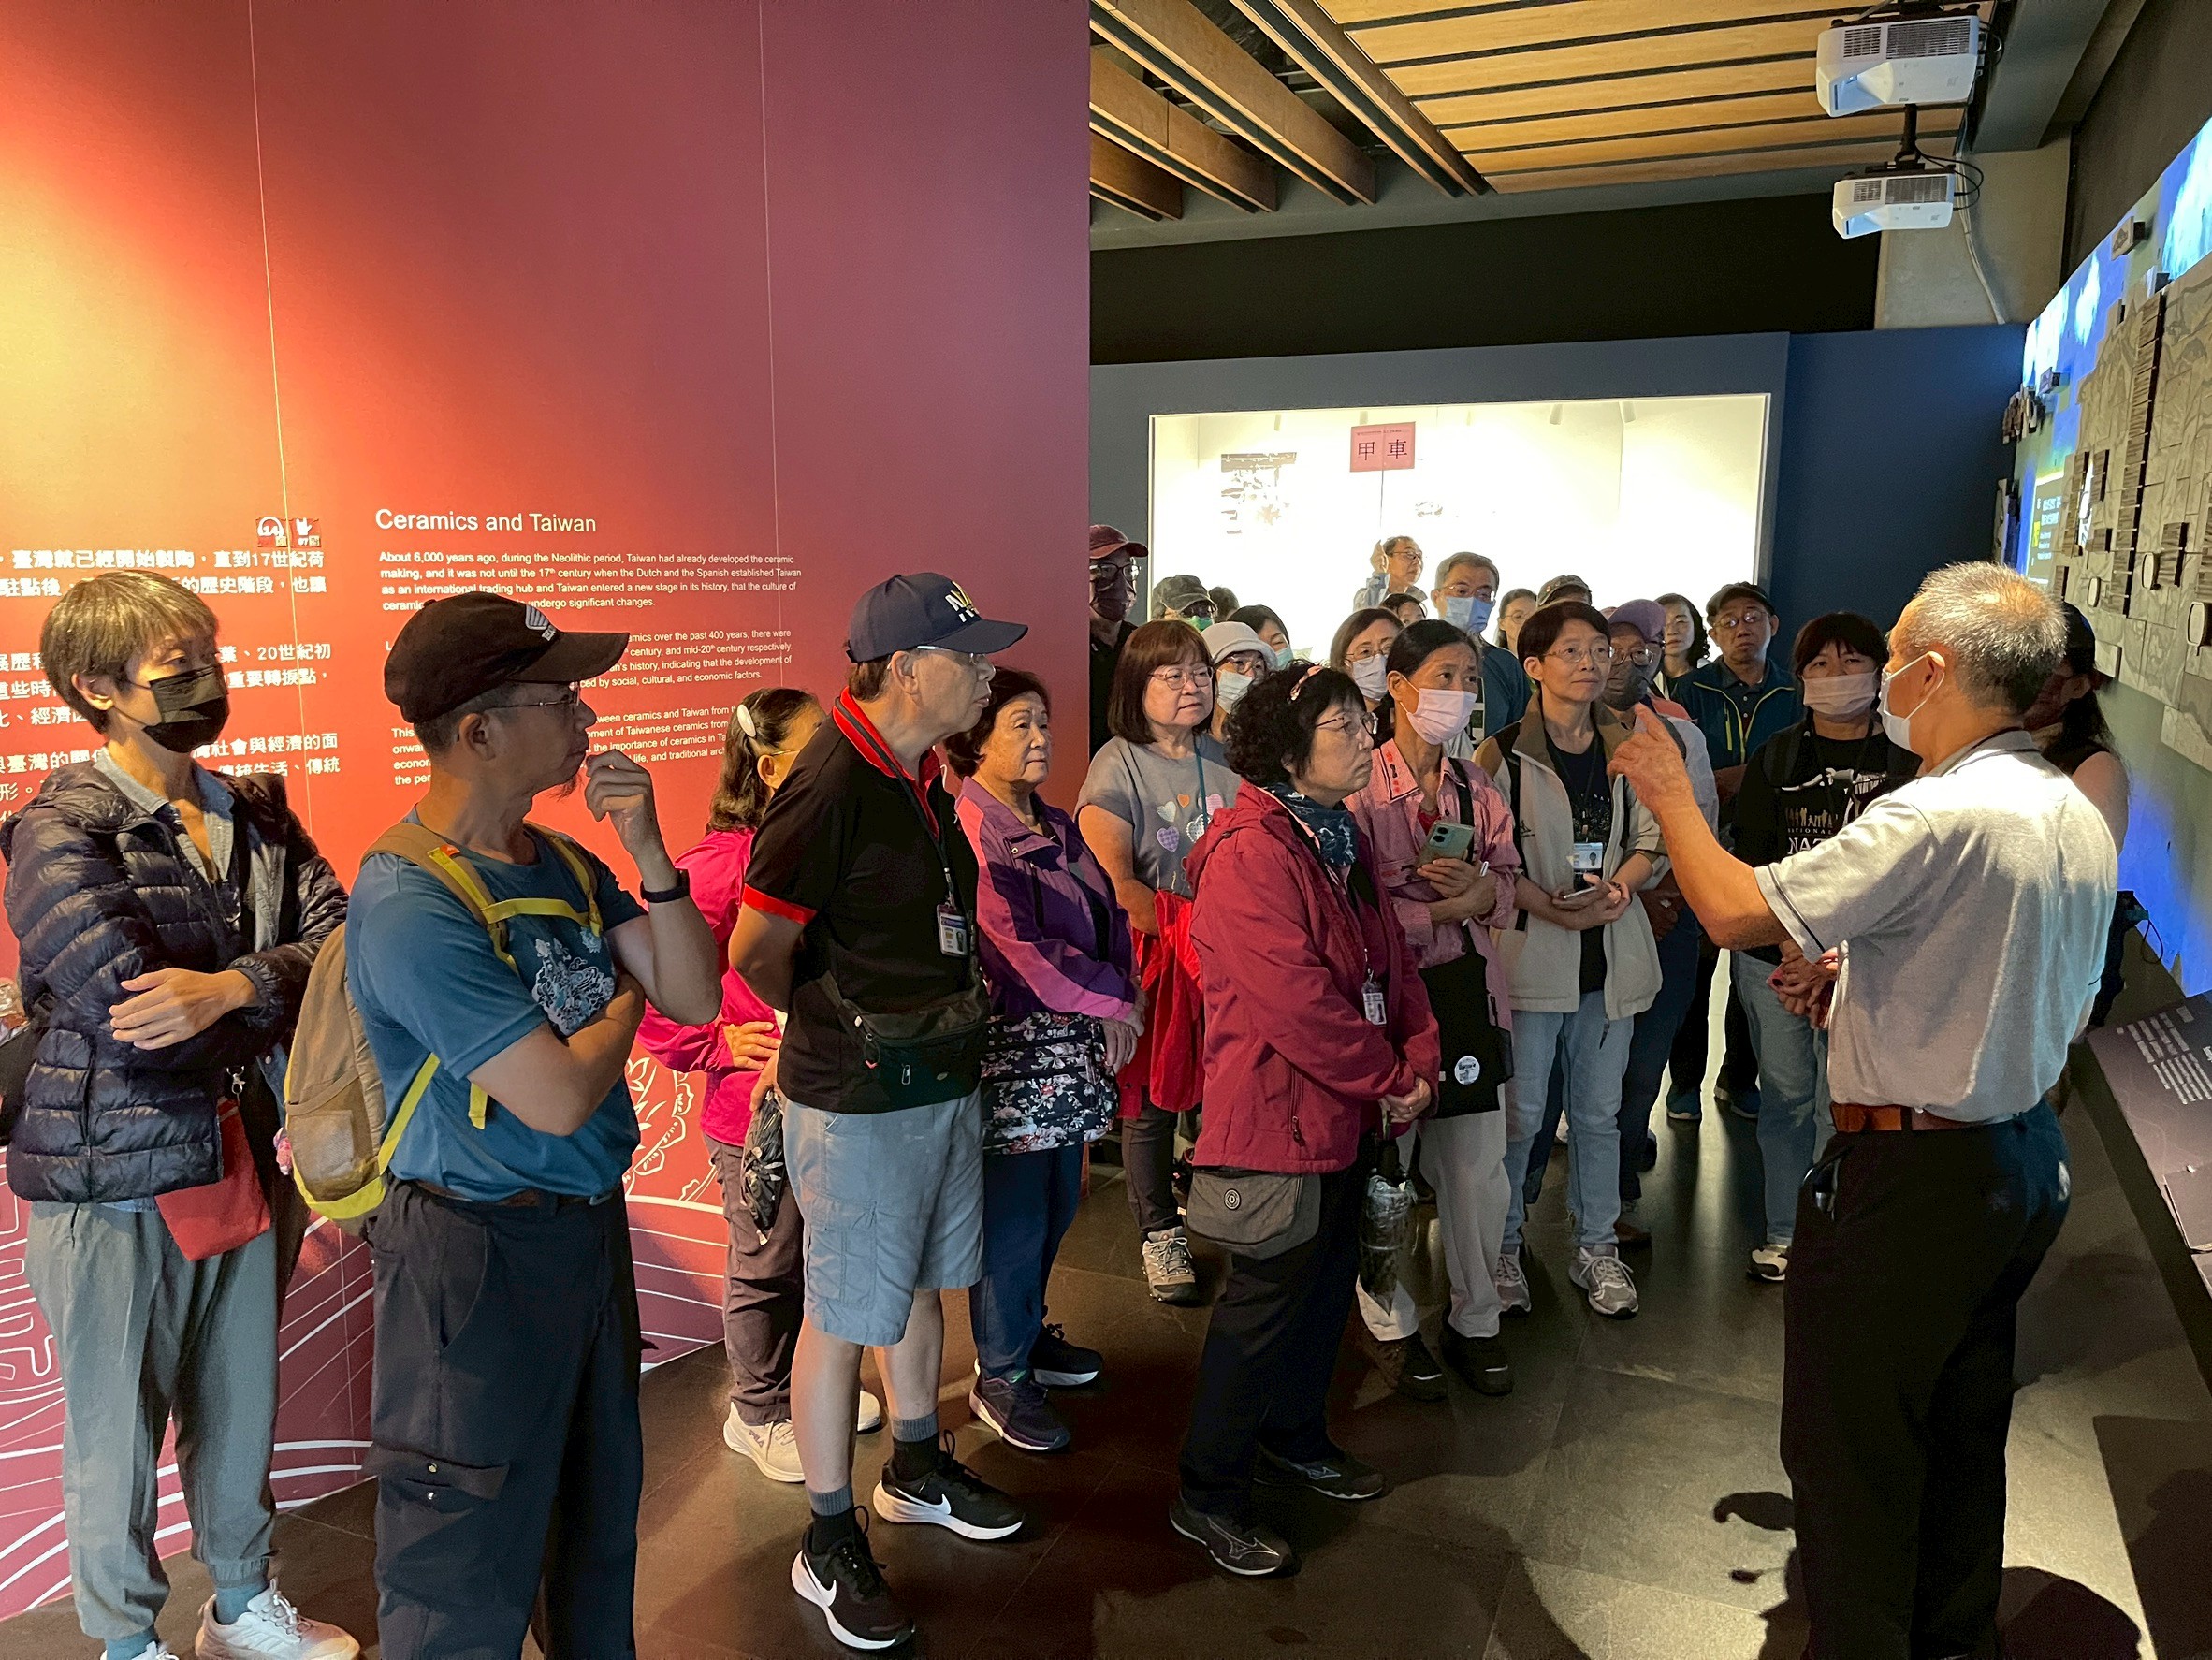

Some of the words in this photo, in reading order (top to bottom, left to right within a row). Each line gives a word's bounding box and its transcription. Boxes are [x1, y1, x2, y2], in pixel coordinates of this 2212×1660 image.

[375, 508, 478, 531] Ceramics
[486, 513, 522, 531] and
[529, 513, 596, 532] Taiwan
[379, 552, 411, 563] About
[414, 552, 444, 564] 6,000
[446, 554, 474, 564] years
[476, 554, 499, 564] ago,
[501, 553, 531, 564] during
[533, 553, 548, 562] the
[551, 553, 591, 563] Neolithic
[593, 554, 624, 564] period,
[626, 554, 656, 563] Taiwan
[659, 554, 675, 563] had
[677, 554, 706, 565] already
[708, 555, 749, 565] developed
[750, 555, 763, 563] the
[764, 555, 794, 563] ceramic
[380, 568, 423, 580] making,
[425, 568, 444, 578] and
[447, 568, 455, 578] it
[457, 570, 477, 578] was
[479, 569, 496, 578] not
[498, 568, 517, 578] until
[520, 568, 536, 577] the
[558, 569, 591, 580] century
[594, 569, 618, 578] when
[620, 568, 634, 577] the
[636, 568, 662, 577] Dutch
[663, 568, 679, 577] and
[681, 568, 694, 577] the
[696, 568, 729, 579] Spanish
[731, 568, 774, 577] established
[776, 568, 802, 577] Taiwan
[382, 586, 395, 594] as
[398, 586, 411, 594] an
[414, 584, 476, 594] international
[479, 583, 513, 595] trading
[516, 584, 533, 593] hub
[536, 584, 554, 593] and
[556, 583, 589, 593] Taiwan
[590, 583, 624, 592] entered
[635, 584, 653, 592] new
[655, 583, 678, 593] stage
[680, 583, 688, 591] in
[690, 582, 699, 591] its
[701, 582, 730, 592] history,
[731, 582, 747, 591] that
[748, 582, 760, 591] the
[762, 582, 787, 591] culture
[788, 581, 797, 590] of
[569, 598, 615, 609] significant
[616, 597, 655, 608] changes.
[628, 633, 652, 643] amics
[654, 633, 673, 643] over
[675, 633, 688, 641] the
[690, 632, 707, 643] past
[708, 631, 724, 640] 400
[726, 631, 749, 642] years,
[751, 630, 771, 639] there
[773, 630, 792, 638] were
[630, 647, 663, 658] century,
[665, 646, 681, 655] and
[716, 644, 745, 655] century
[747, 642, 792, 653] respectively.
[609, 663, 627, 673] an's
[629, 660, 660, 672] history,
[662, 659, 701, 670] indicating
[703, 659, 718, 668] that
[720, 658, 732, 666] the
[734, 656, 782, 667] development
[784, 655, 793, 663] of
[598, 678, 610, 689] by
[611, 677, 639, 687] social,
[641, 675, 675, 685] cultural,
[677, 675, 692, 683] and
[694, 672, 733, 682] economic
[734, 670, 763, 680] factors.
[596, 714, 621, 723] ween
[623, 711, 662, 721] ceramics
[663, 709, 680, 719] and
[681, 706, 709, 718] Taiwan
[711, 706, 729, 716] from
[391, 727, 415, 738] This
[615, 725, 624, 735] of
[626, 723, 671, 735] Taiwanese
[673, 721, 709, 732] ceramics
[710, 720, 729, 730] from
[594, 742, 608, 752] the
[610, 738, 658, 751] importance
[660, 736, 668, 746] of
[669, 734, 706, 745] ceramics
[707, 733, 716, 742] in
[650, 752, 667, 762] and
[669, 749, 708, 759] traditional
[395, 775, 412, 786] the
